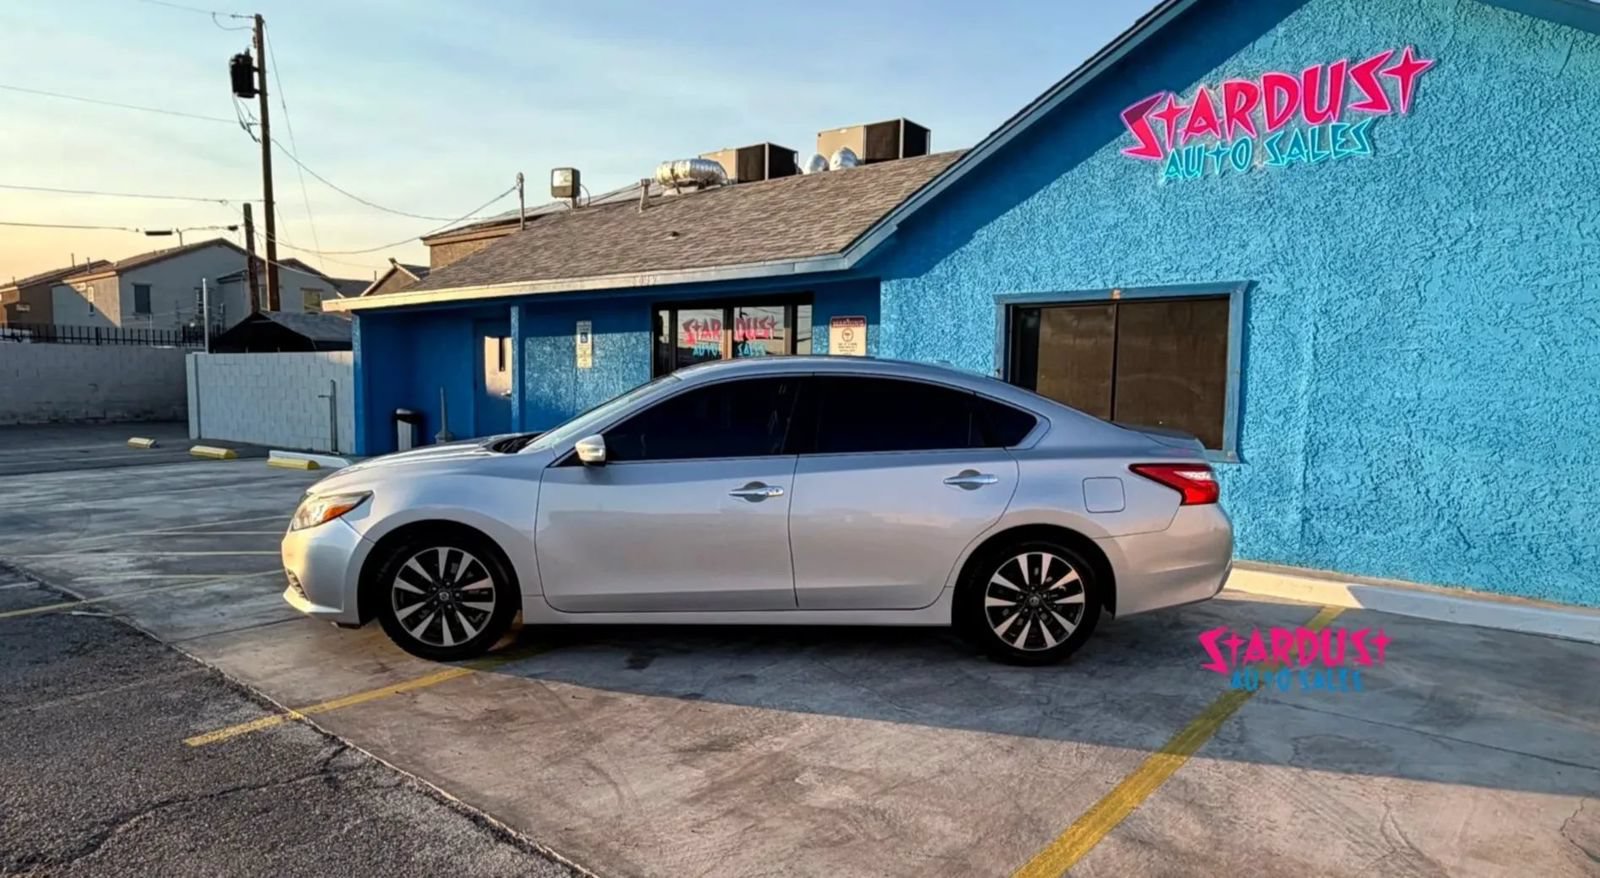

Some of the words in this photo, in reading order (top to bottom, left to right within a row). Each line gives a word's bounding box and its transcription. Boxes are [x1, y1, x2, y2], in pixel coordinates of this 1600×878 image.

[1120, 44, 1436, 160] STARDUST
[1159, 136, 1253, 181] AUTO
[1263, 117, 1373, 167] SALES
